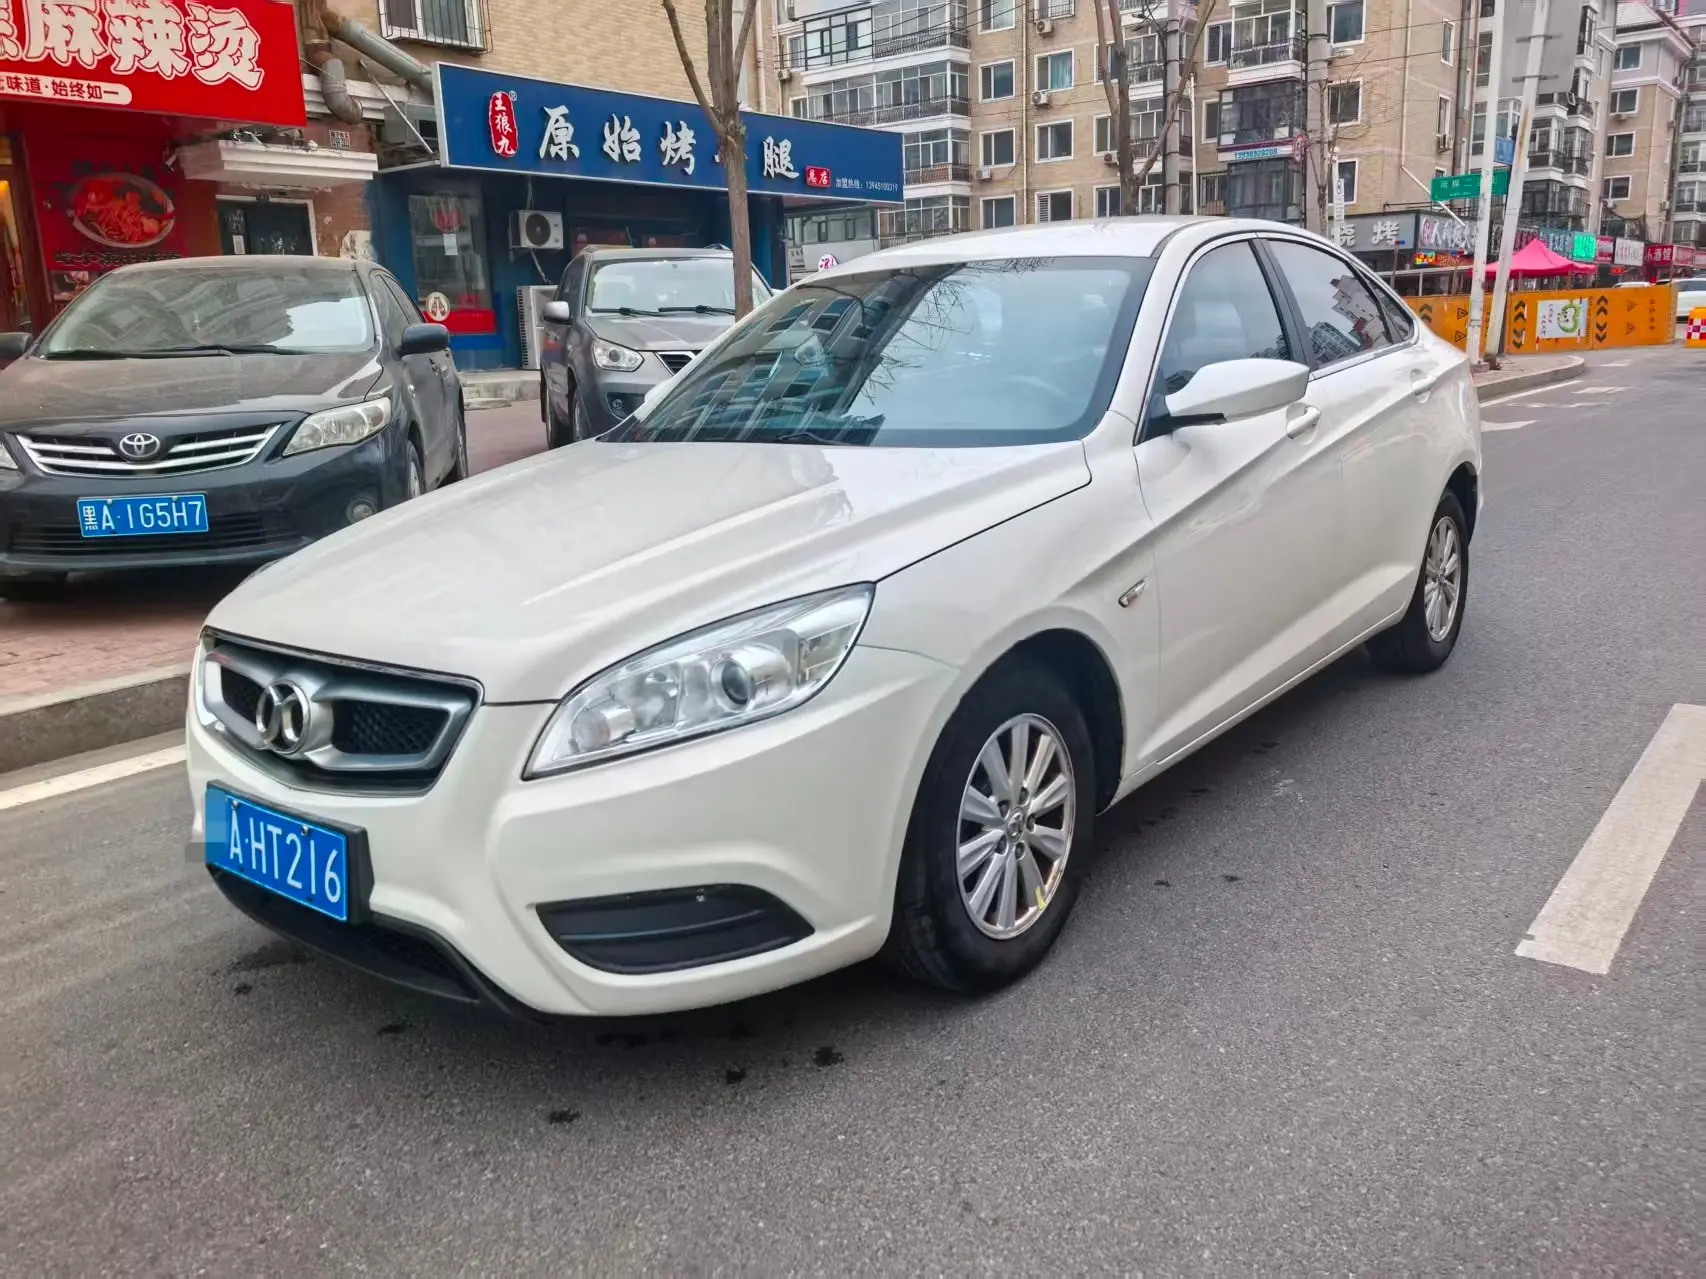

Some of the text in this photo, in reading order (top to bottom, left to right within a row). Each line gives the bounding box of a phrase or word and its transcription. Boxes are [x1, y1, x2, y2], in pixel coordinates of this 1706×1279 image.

[539, 104, 800, 180] 原始烤腿
[229, 809, 342, 904] A·HT216
